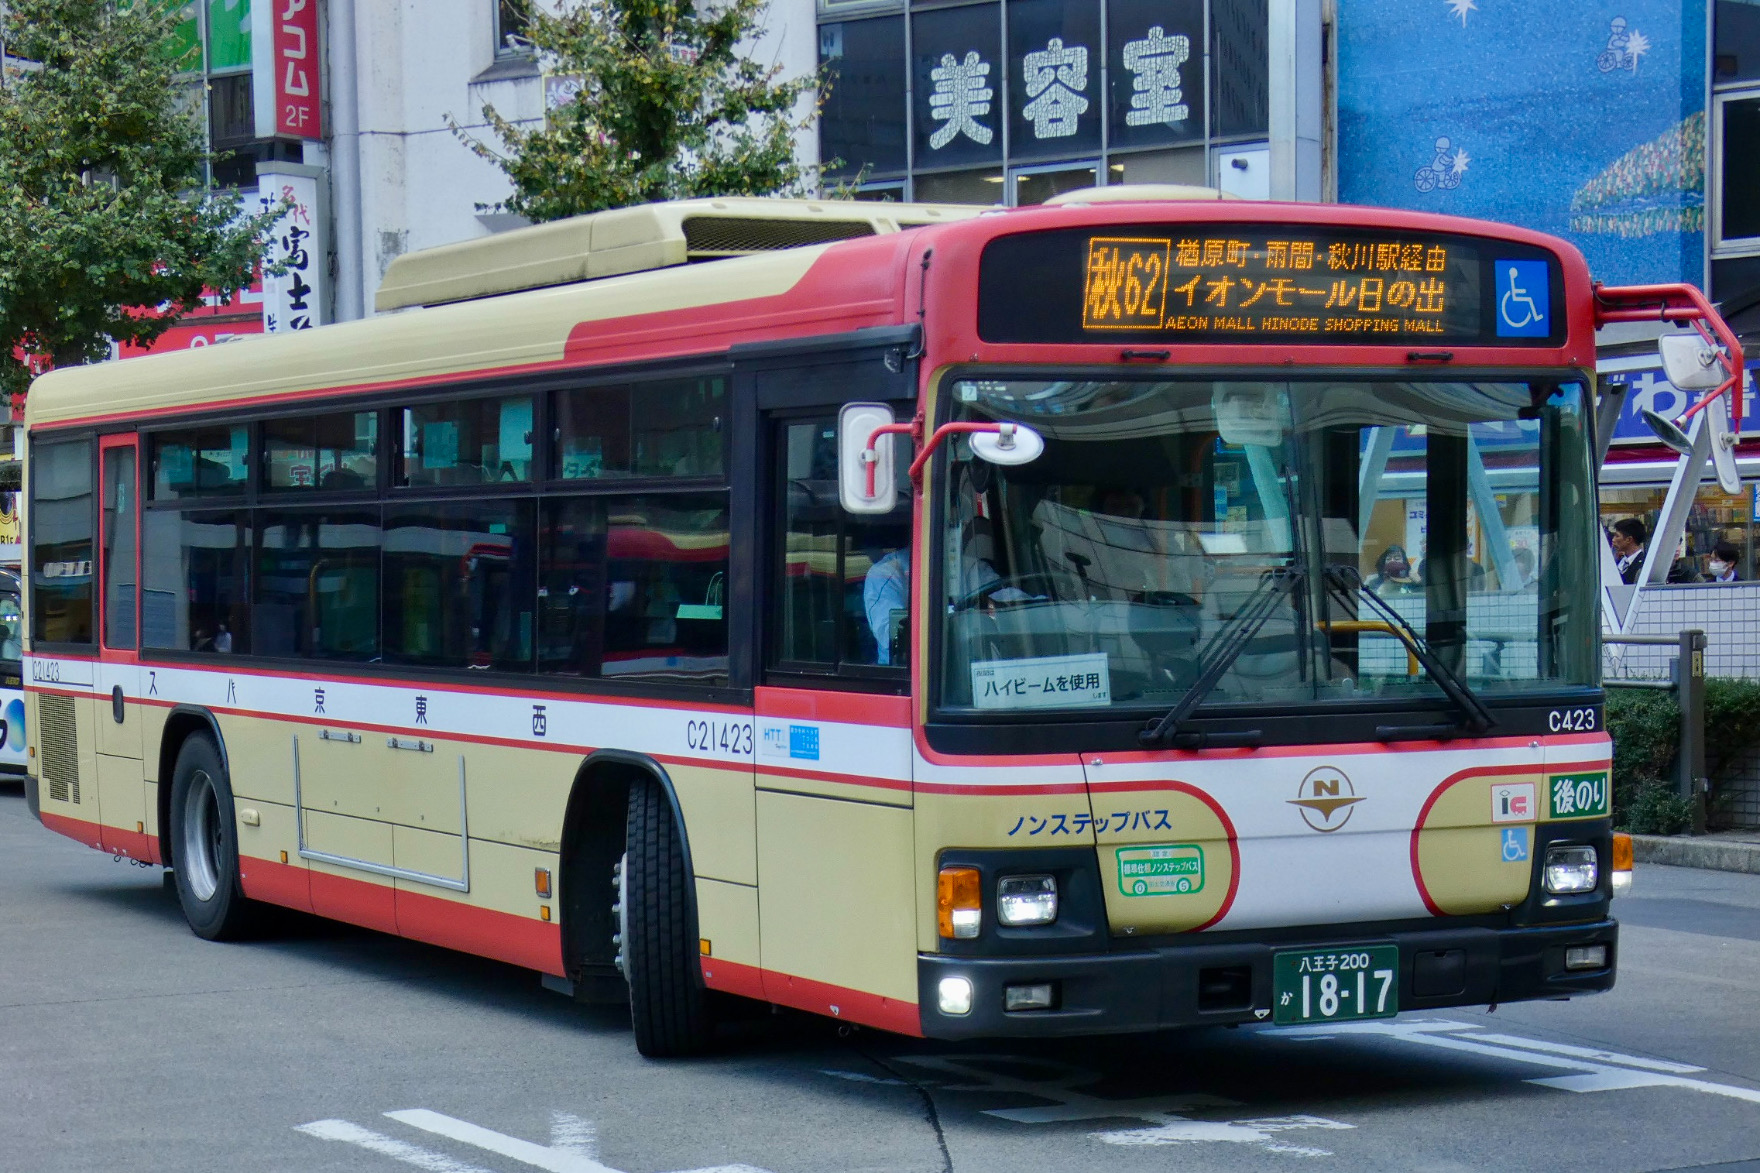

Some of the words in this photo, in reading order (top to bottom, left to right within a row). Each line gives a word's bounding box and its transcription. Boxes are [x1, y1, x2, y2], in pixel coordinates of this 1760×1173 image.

[929, 26, 1190, 150] 美容室
[286, 105, 309, 127] 2F
[1088, 247, 1161, 320] 秋62
[1175, 275, 1446, 313] イオンモール日の出
[1165, 316, 1208, 330] AEON
[1214, 316, 1255, 330] MALL
[1262, 317, 1319, 332] HINODE
[1325, 318, 1399, 333] SHOPPING
[1404, 319, 1445, 333] MALL
[33, 660, 60, 681] C21423
[149, 671, 158, 696] ス
[984, 672, 1100, 698] ハイビームを使用
[314, 686, 326, 714] 京
[415, 694, 428, 725] 東
[532, 704, 547, 737] 西
[1549, 708, 1595, 732] C423
[687, 719, 753, 755] C21423
[1553, 777, 1606, 815] 後のり
[1008, 809, 1173, 837] ノンステップバス
[1299, 954, 1339, 973] 八王子
[1340, 952, 1369, 970] 200
[1280, 991, 1293, 1006] か
[1302, 969, 1393, 1018] 18-17
